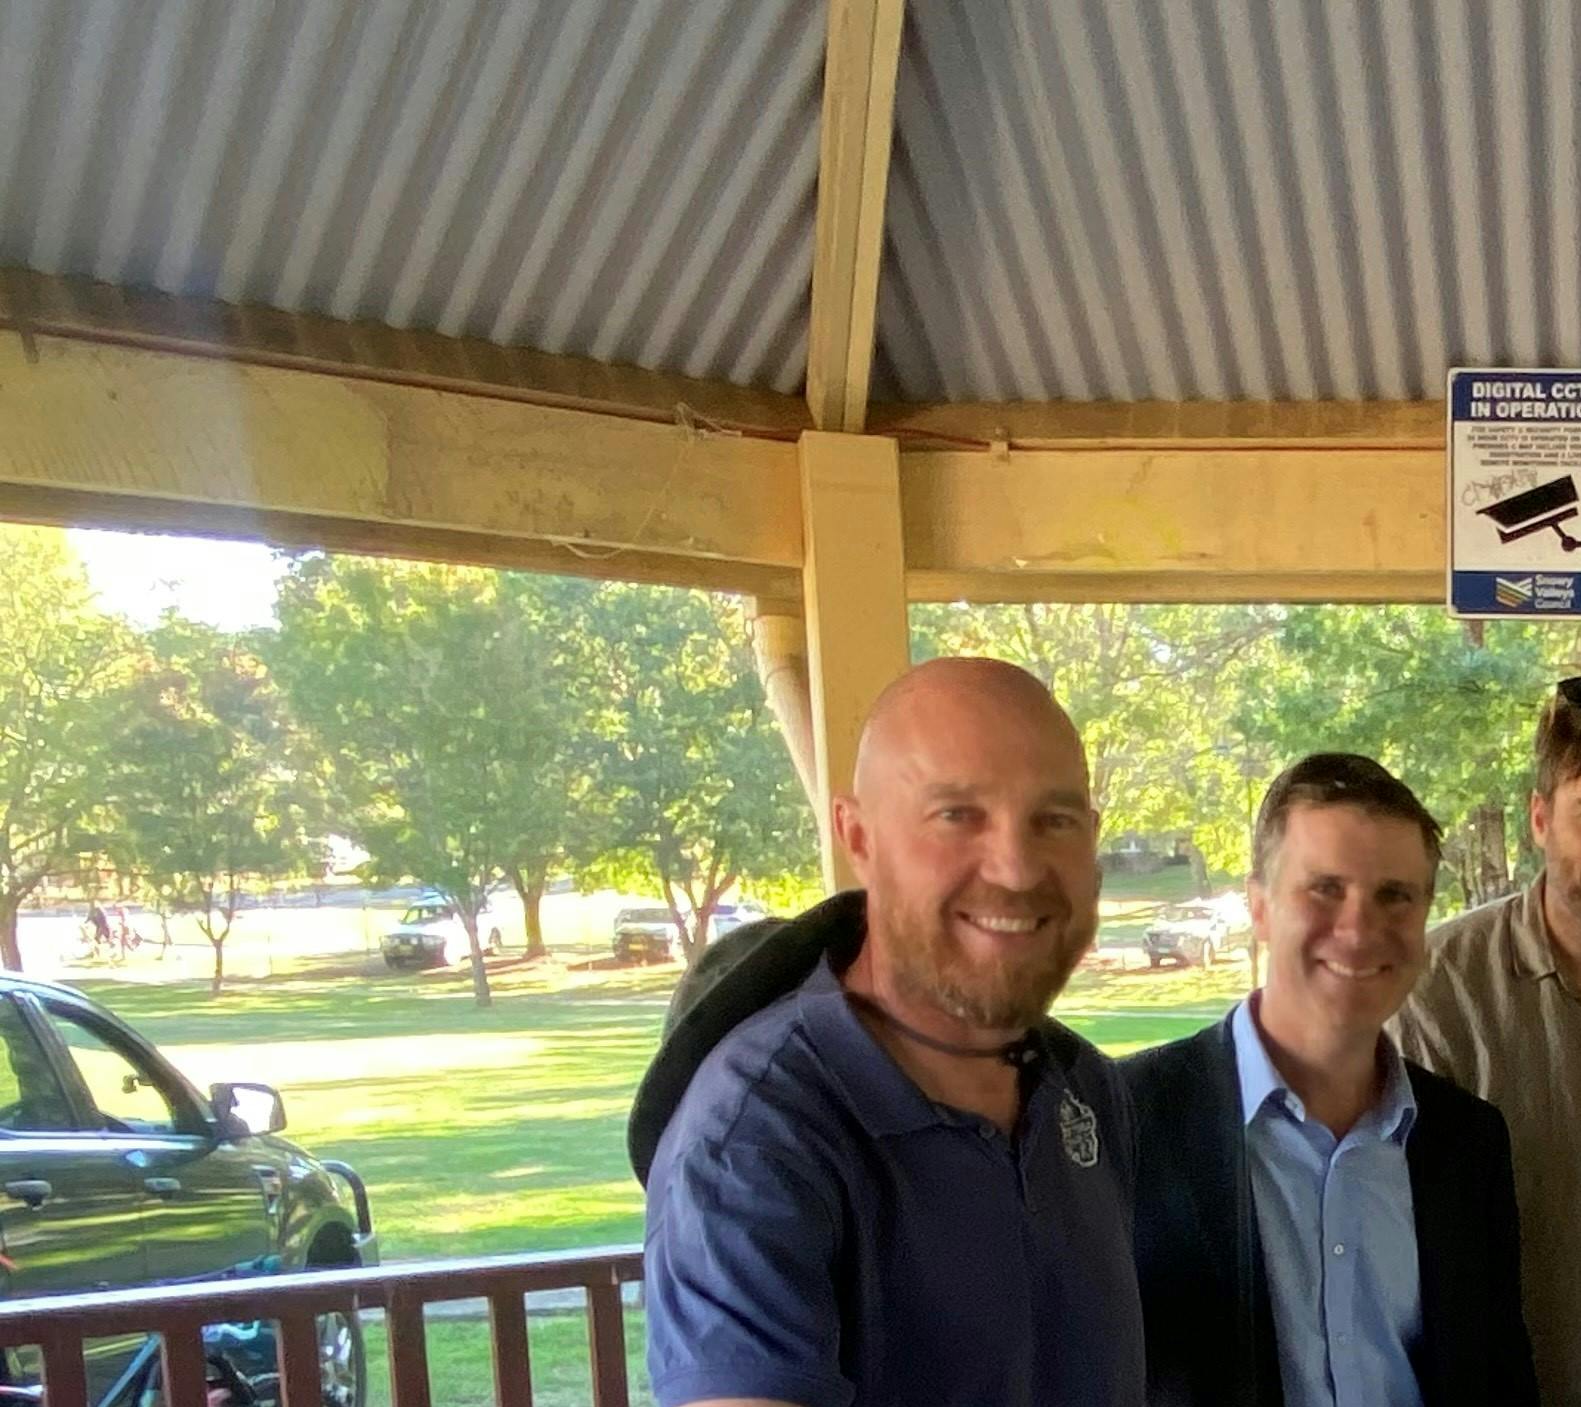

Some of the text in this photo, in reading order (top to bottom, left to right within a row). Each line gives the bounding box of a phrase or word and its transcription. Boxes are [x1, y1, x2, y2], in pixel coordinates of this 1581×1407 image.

[1472, 382, 1546, 399] DIGITAL
[1470, 403, 1490, 418] IN
[1534, 574, 1574, 589] Snowy
[1534, 586, 1575, 600] Valleys
[1534, 598, 1572, 609] Council
